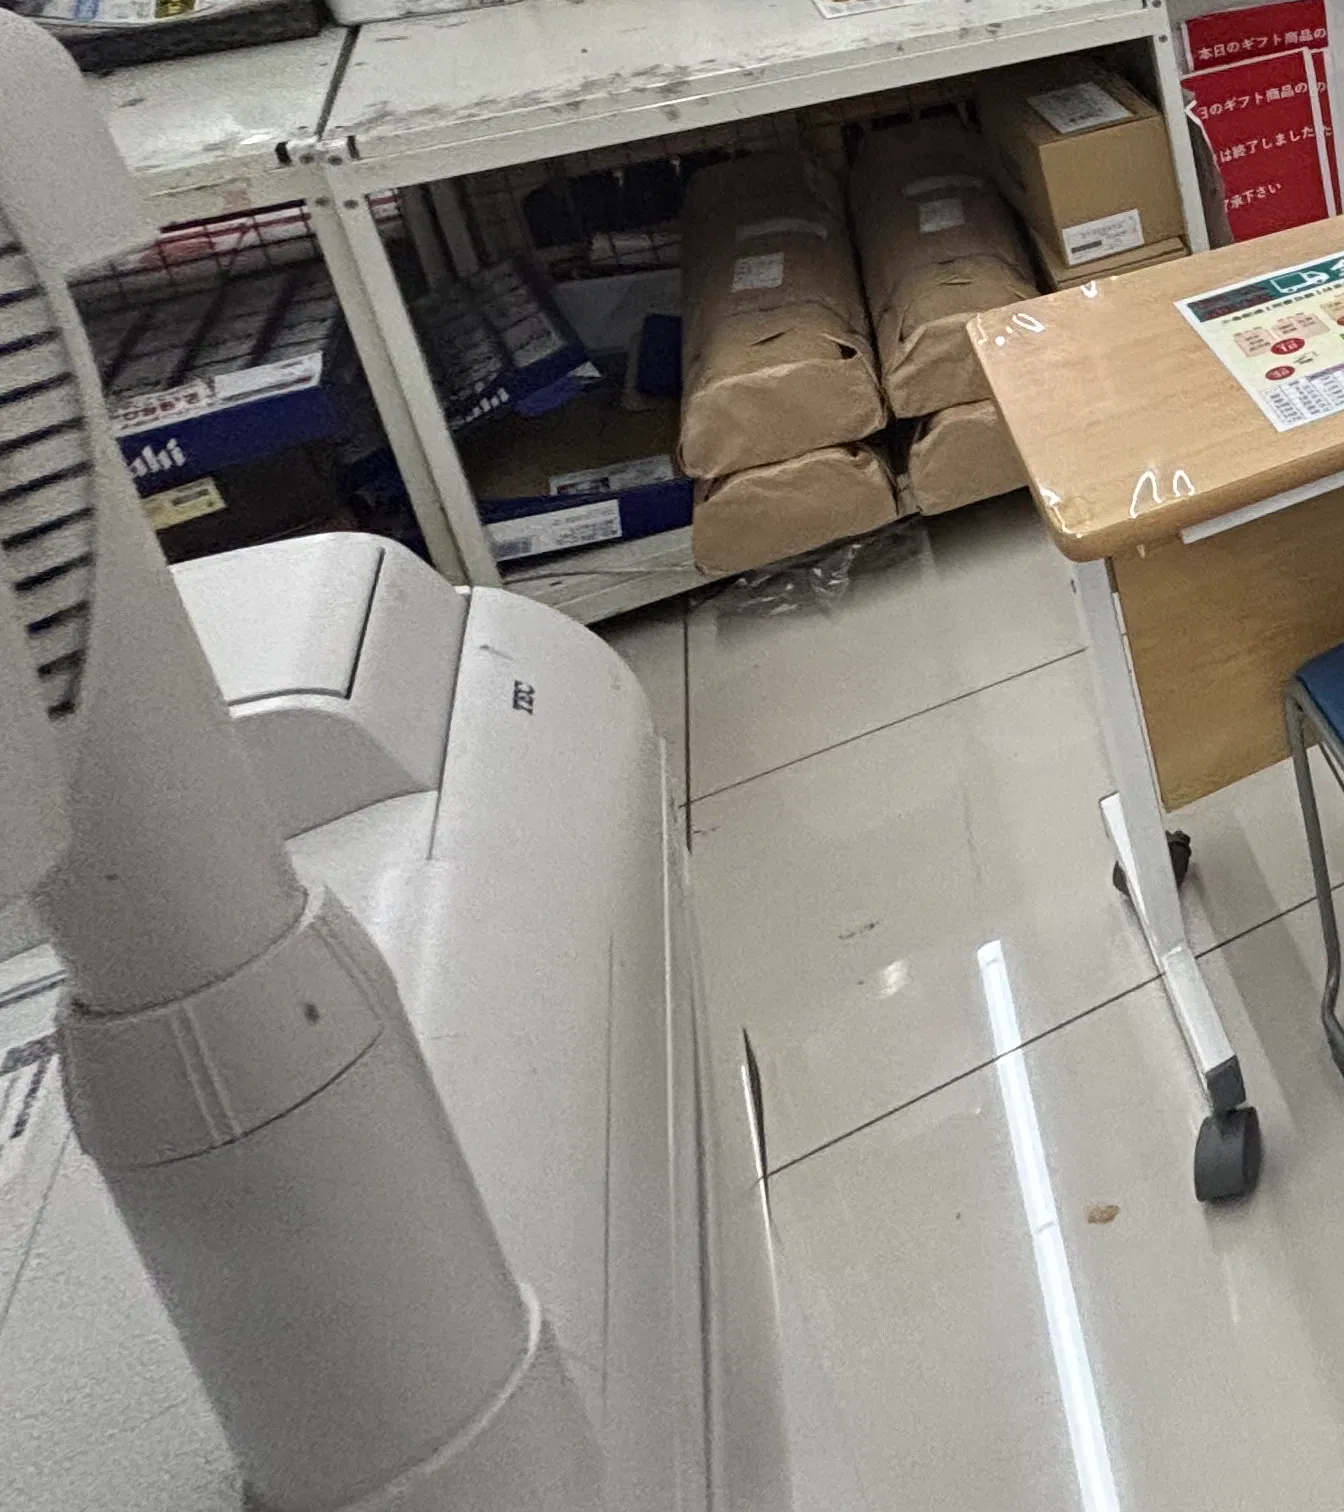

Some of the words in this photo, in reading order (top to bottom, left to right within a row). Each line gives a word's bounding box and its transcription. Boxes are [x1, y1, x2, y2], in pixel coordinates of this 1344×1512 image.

[1198, 81, 1308, 122] 日のギフト商品の
[1219, 125, 1315, 164] は終了しました
[128, 437, 188, 479] ahi
